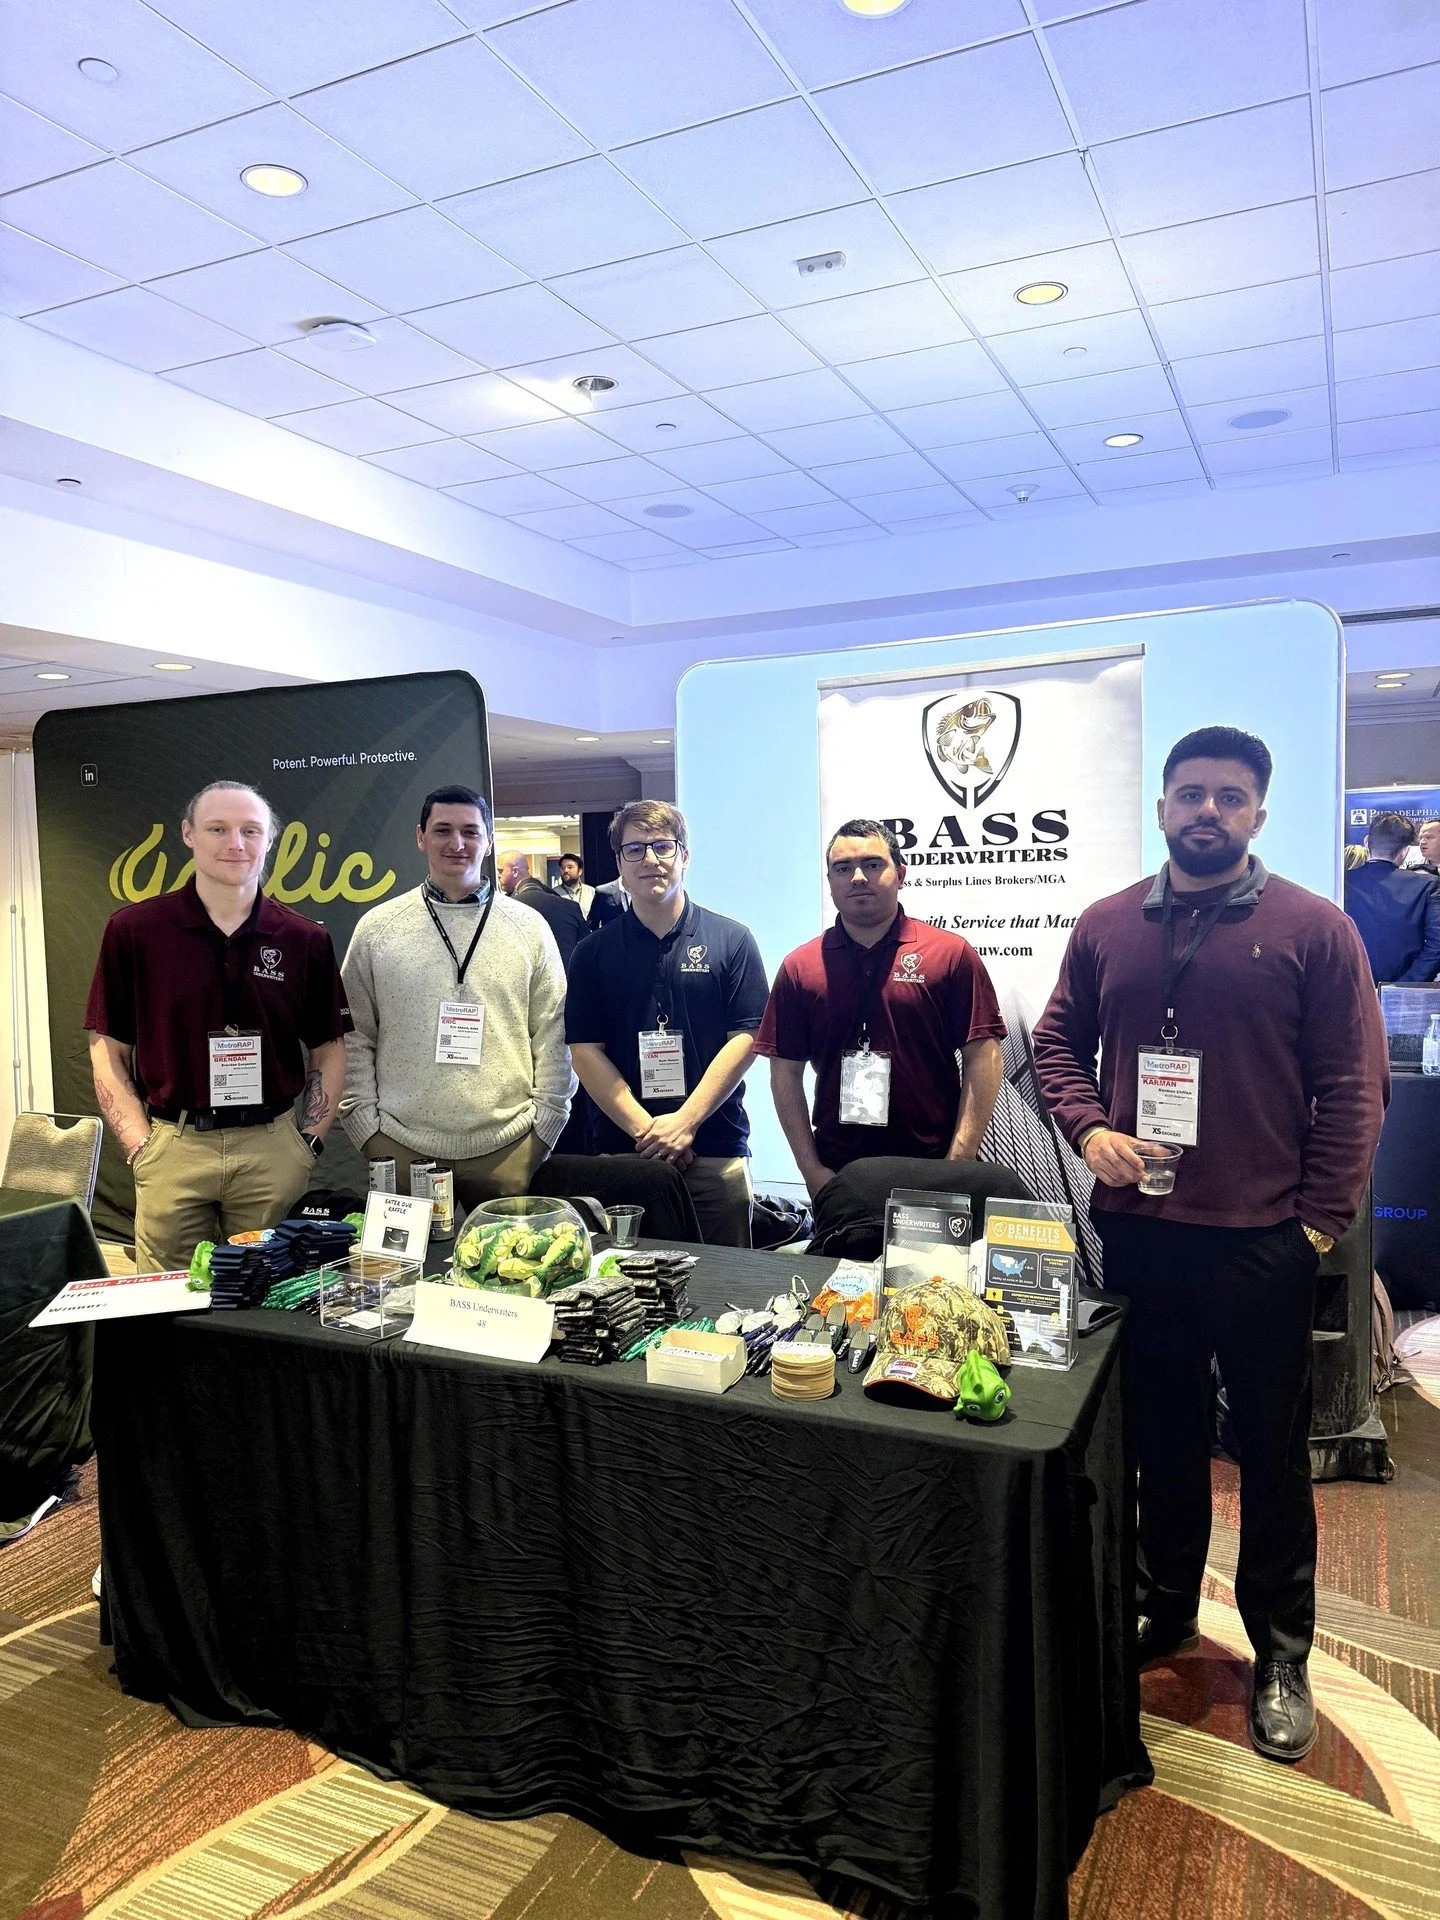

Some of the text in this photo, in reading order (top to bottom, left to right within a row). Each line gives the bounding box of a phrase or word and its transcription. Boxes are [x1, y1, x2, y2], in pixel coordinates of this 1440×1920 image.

[272, 750, 418, 770] Potent. Powerful. Protective.
[1370, 808, 1439, 818] PHADELPHIA
[879, 809, 1070, 850] BASS
[109, 820, 397, 904] Glic
[900, 848, 1068, 866] NDERWRITERS
[914, 878, 923, 887] &
[925, 876, 963, 888] Surplus
[965, 876, 992, 886] Lines
[994, 874, 1066, 885] Brokers/MGA
[922, 914, 1080, 928] ith Service that Mat
[253, 966, 284, 977] BASS
[892, 971, 926, 980] BASS
[217, 1041, 252, 1049] MetroRAP
[1146, 1060, 1188, 1070] MetroRAP
[1143, 1078, 1177, 1088] KARMAN
[388, 1206, 407, 1215] RAFFLE
[1374, 1206, 1428, 1220] GROUP
[893, 1218, 940, 1229] UNDERWRITERS
[1008, 1224, 1060, 1239] BENEFITS
[74, 1281, 111, 1290] Door
[117, 1277, 154, 1285] Prize
[61, 1290, 104, 1299] Prize:
[49, 1302, 108, 1313] Winner:
[450, 1298, 518, 1318] BASS Underwriters
[477, 1320, 486, 1328] 48
